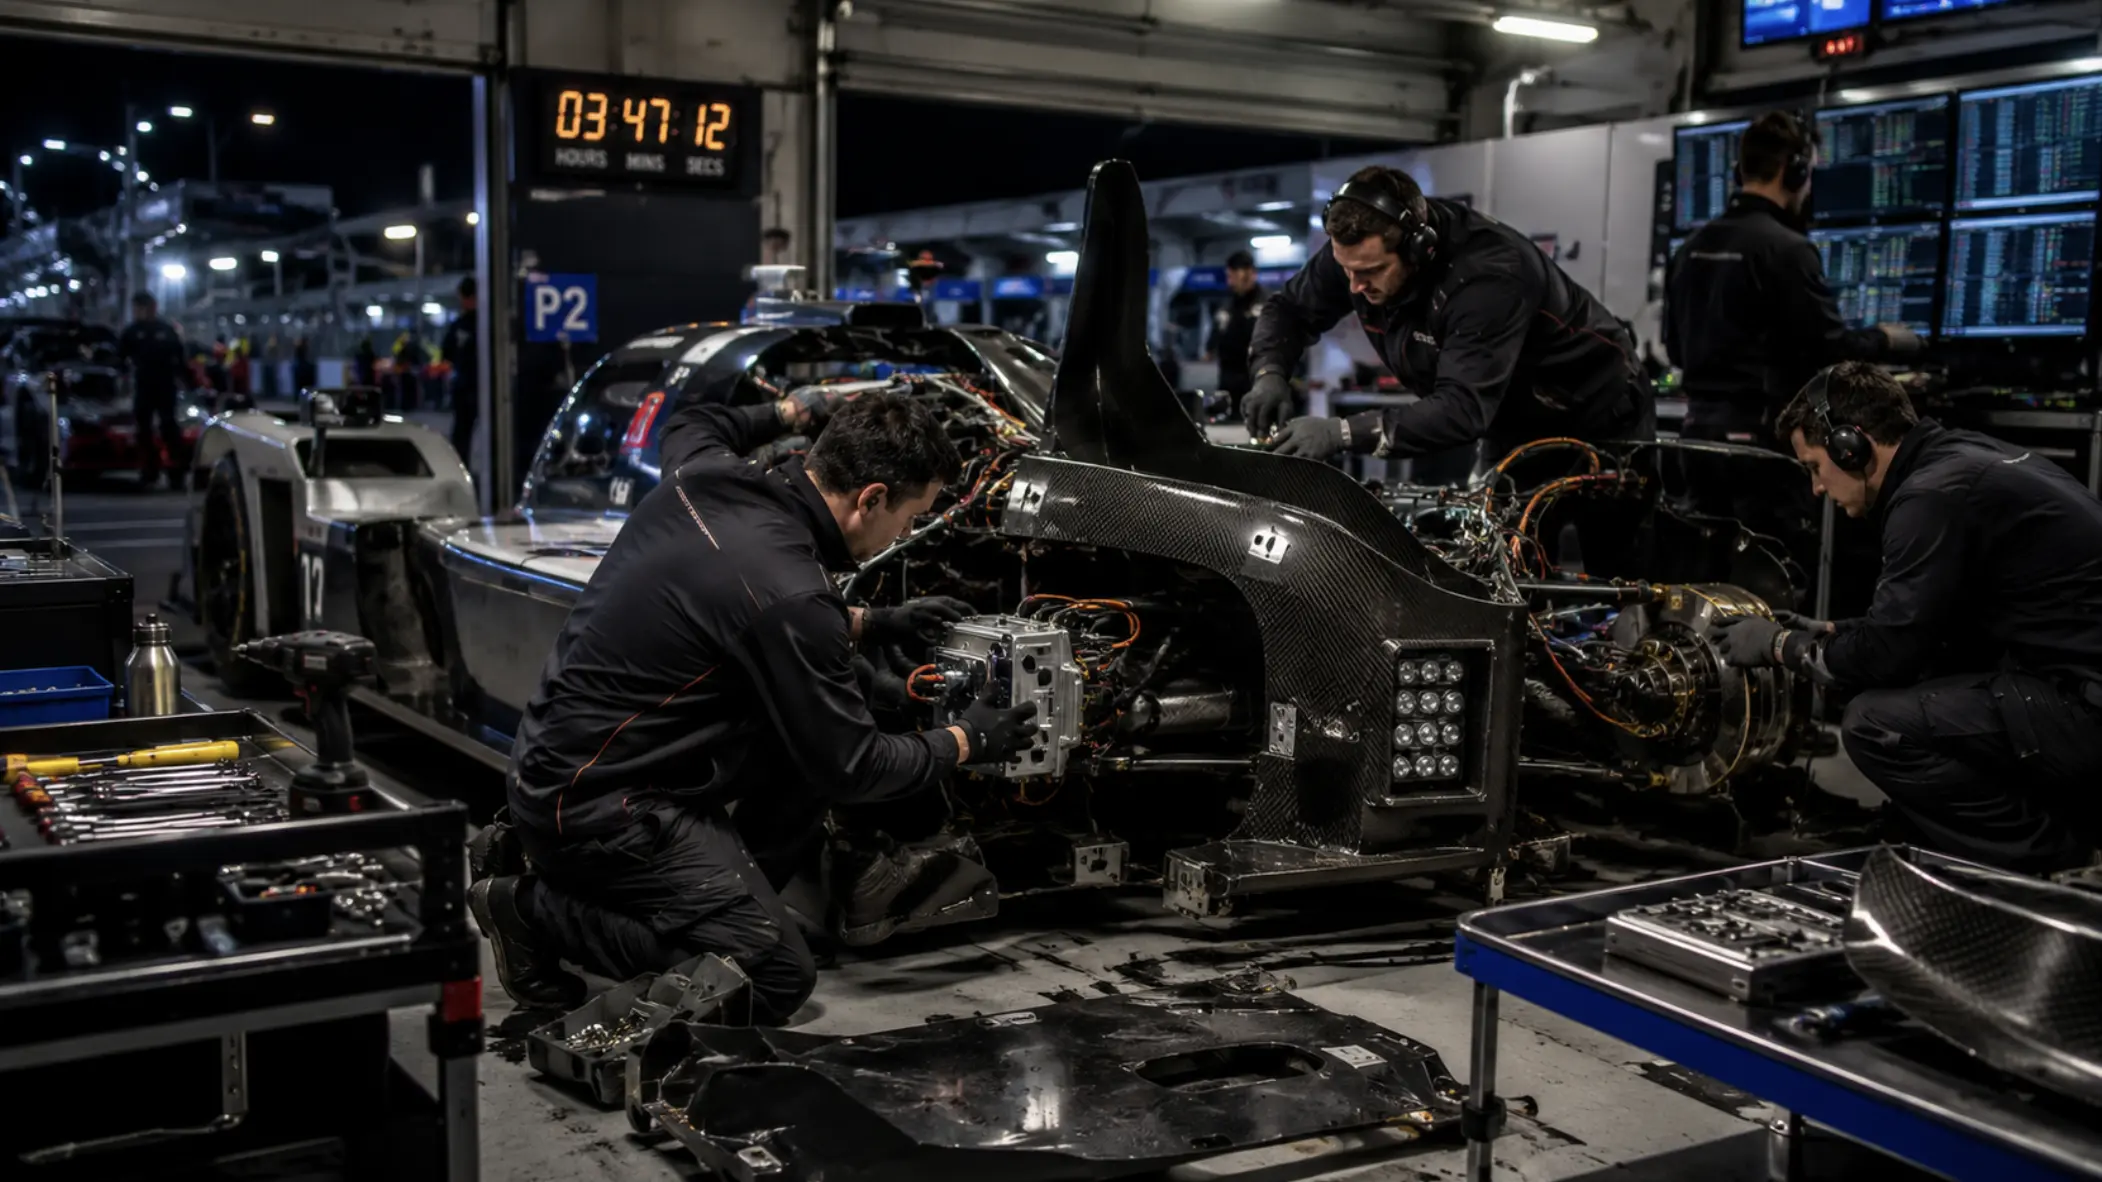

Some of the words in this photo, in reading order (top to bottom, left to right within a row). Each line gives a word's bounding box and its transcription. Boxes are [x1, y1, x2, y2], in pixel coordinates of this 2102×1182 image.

[555, 148, 608, 169] HOURS
[624, 152, 666, 173] MINS
[685, 156, 726, 177] SECS
[534, 284, 589, 332] P2
